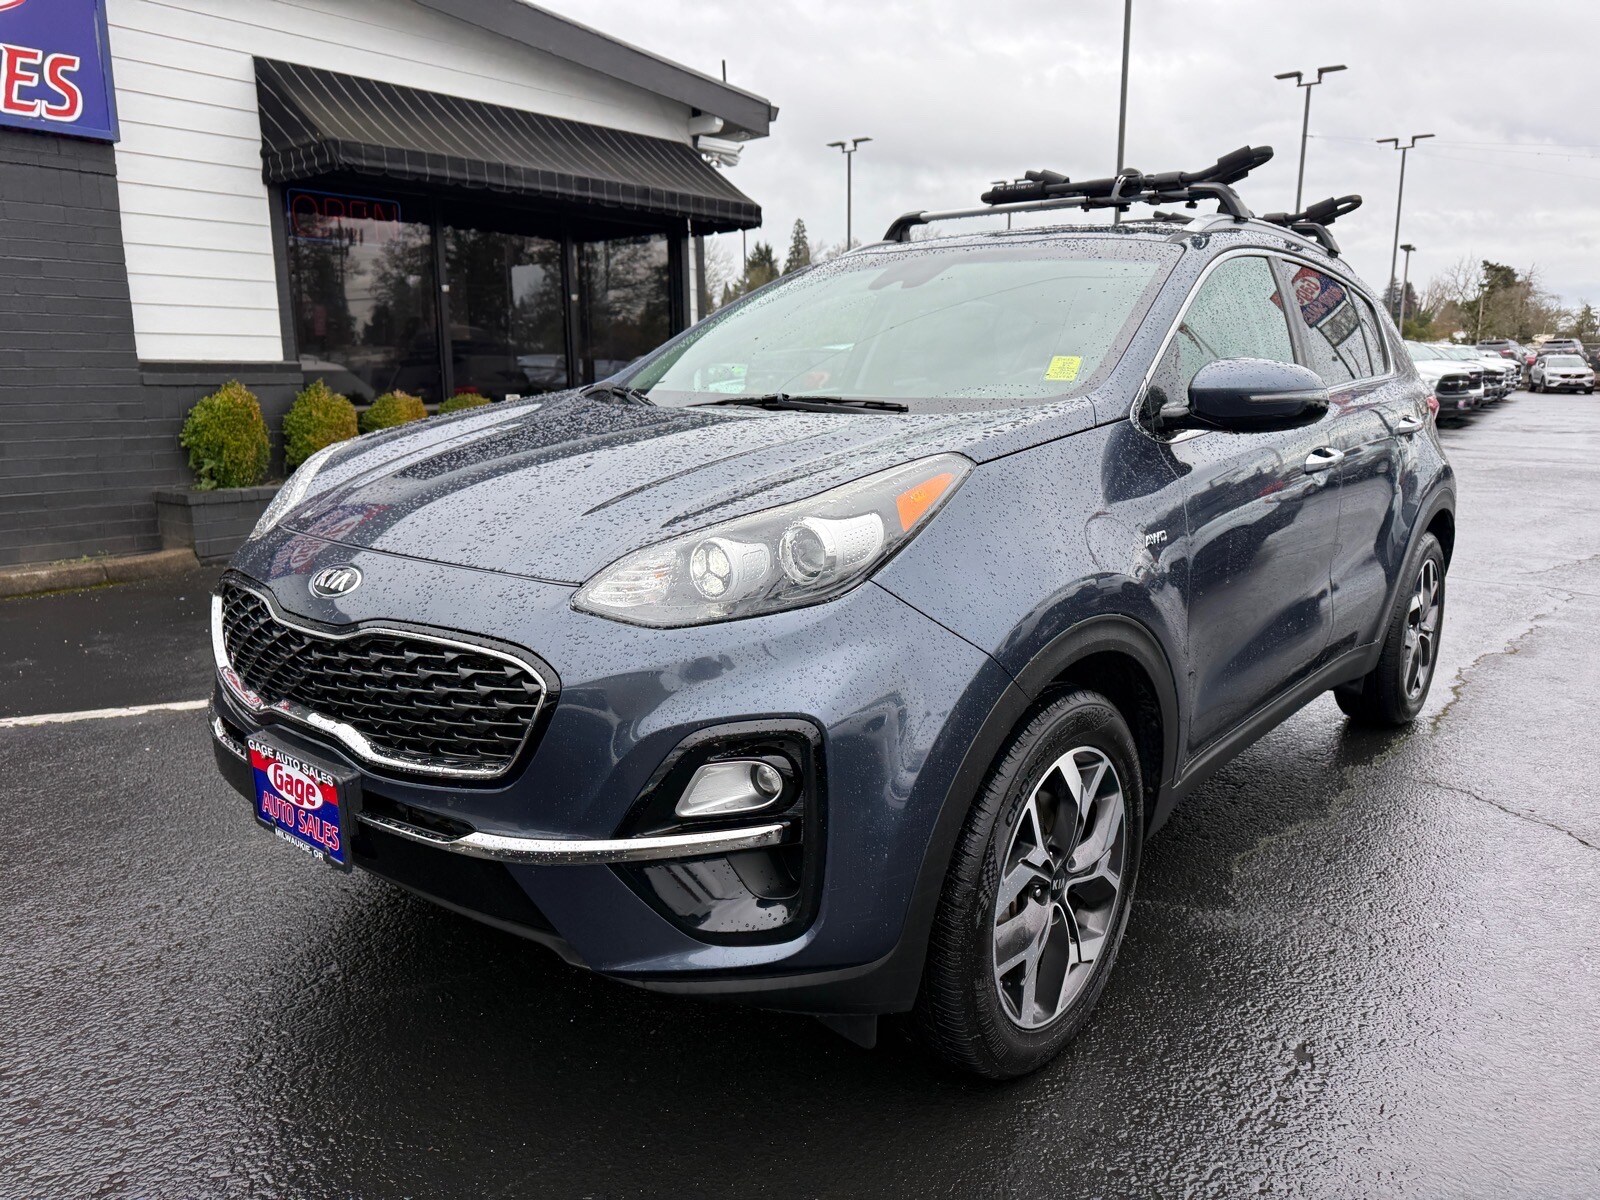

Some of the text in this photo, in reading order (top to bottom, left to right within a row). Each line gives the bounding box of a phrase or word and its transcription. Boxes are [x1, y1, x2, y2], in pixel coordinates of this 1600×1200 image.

[292, 195, 397, 241] OPEN
[1145, 530, 1167, 547] AWD
[315, 569, 351, 591] KIA
[248, 740, 333, 787] GAGE AUTO SALES
[273, 764, 316, 807] Gage
[262, 790, 340, 851] AUTO SALES
[313, 850, 324, 861] OR
[1052, 878, 1065, 890] KIA
